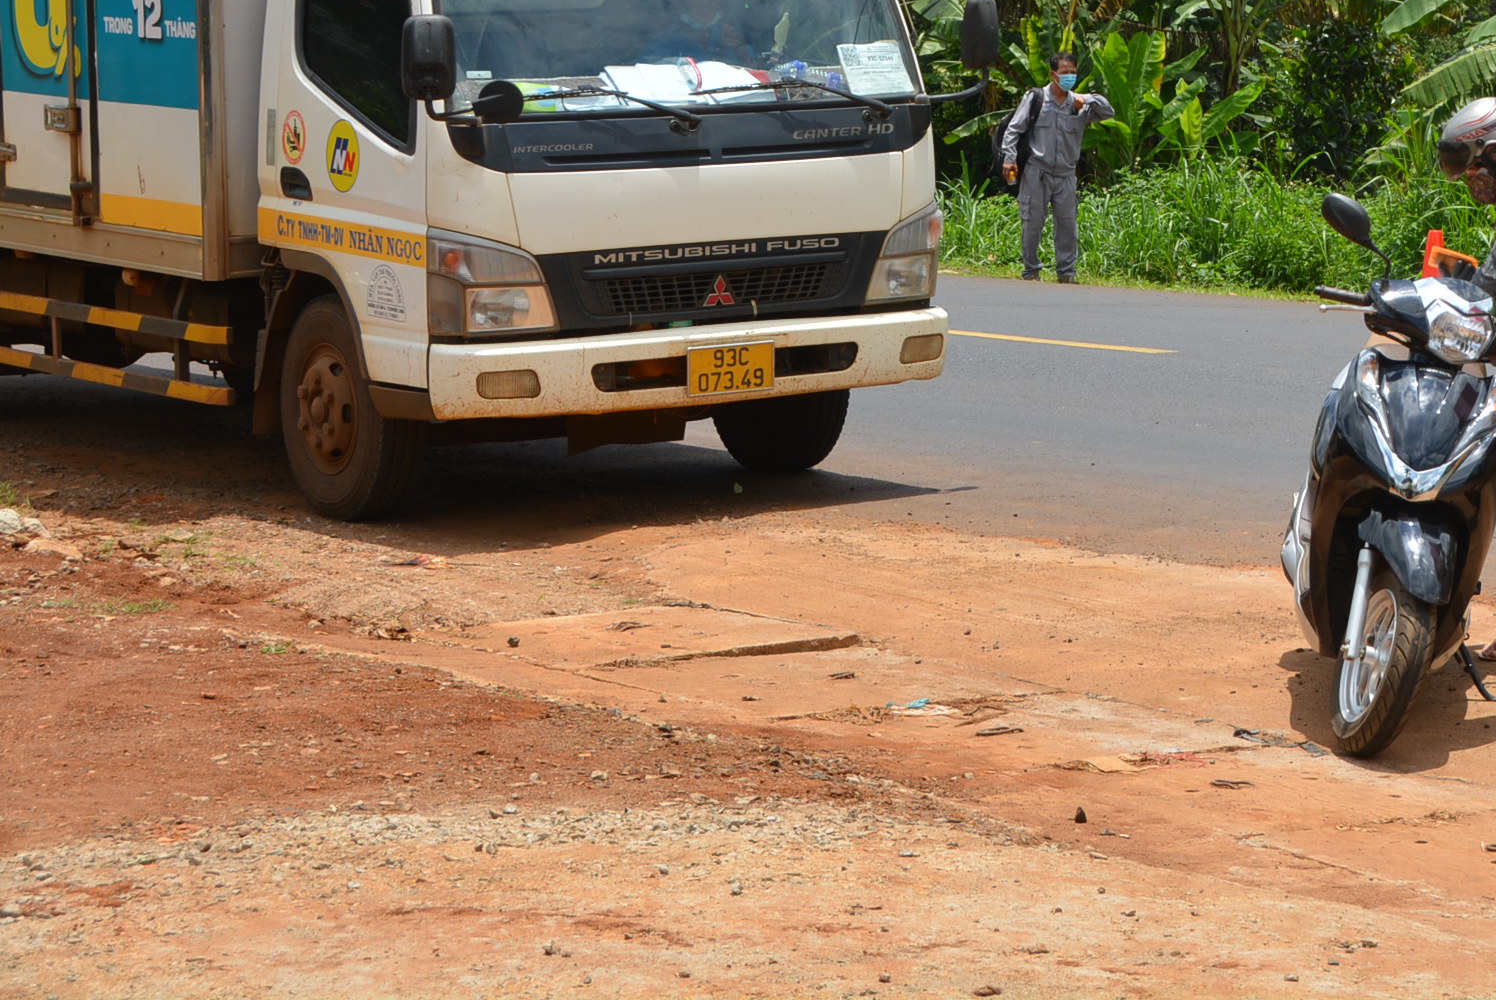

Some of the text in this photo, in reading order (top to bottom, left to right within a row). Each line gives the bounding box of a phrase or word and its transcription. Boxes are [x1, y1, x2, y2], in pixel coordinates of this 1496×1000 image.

[103, 16, 133, 35] TRONG
[164, 16, 196, 39] THÁNG
[792, 123, 895, 140] CANTER HD
[512, 143, 594, 154] INTERCOOLER
[277, 214, 295, 238] C.TY
[349, 229, 383, 254] NHÂN
[386, 236, 422, 263] NGỌC
[594, 237, 840, 265] MITSUBISHI FUSO
[713, 347, 749, 368] 93C
[698, 368, 764, 392] 073.49
